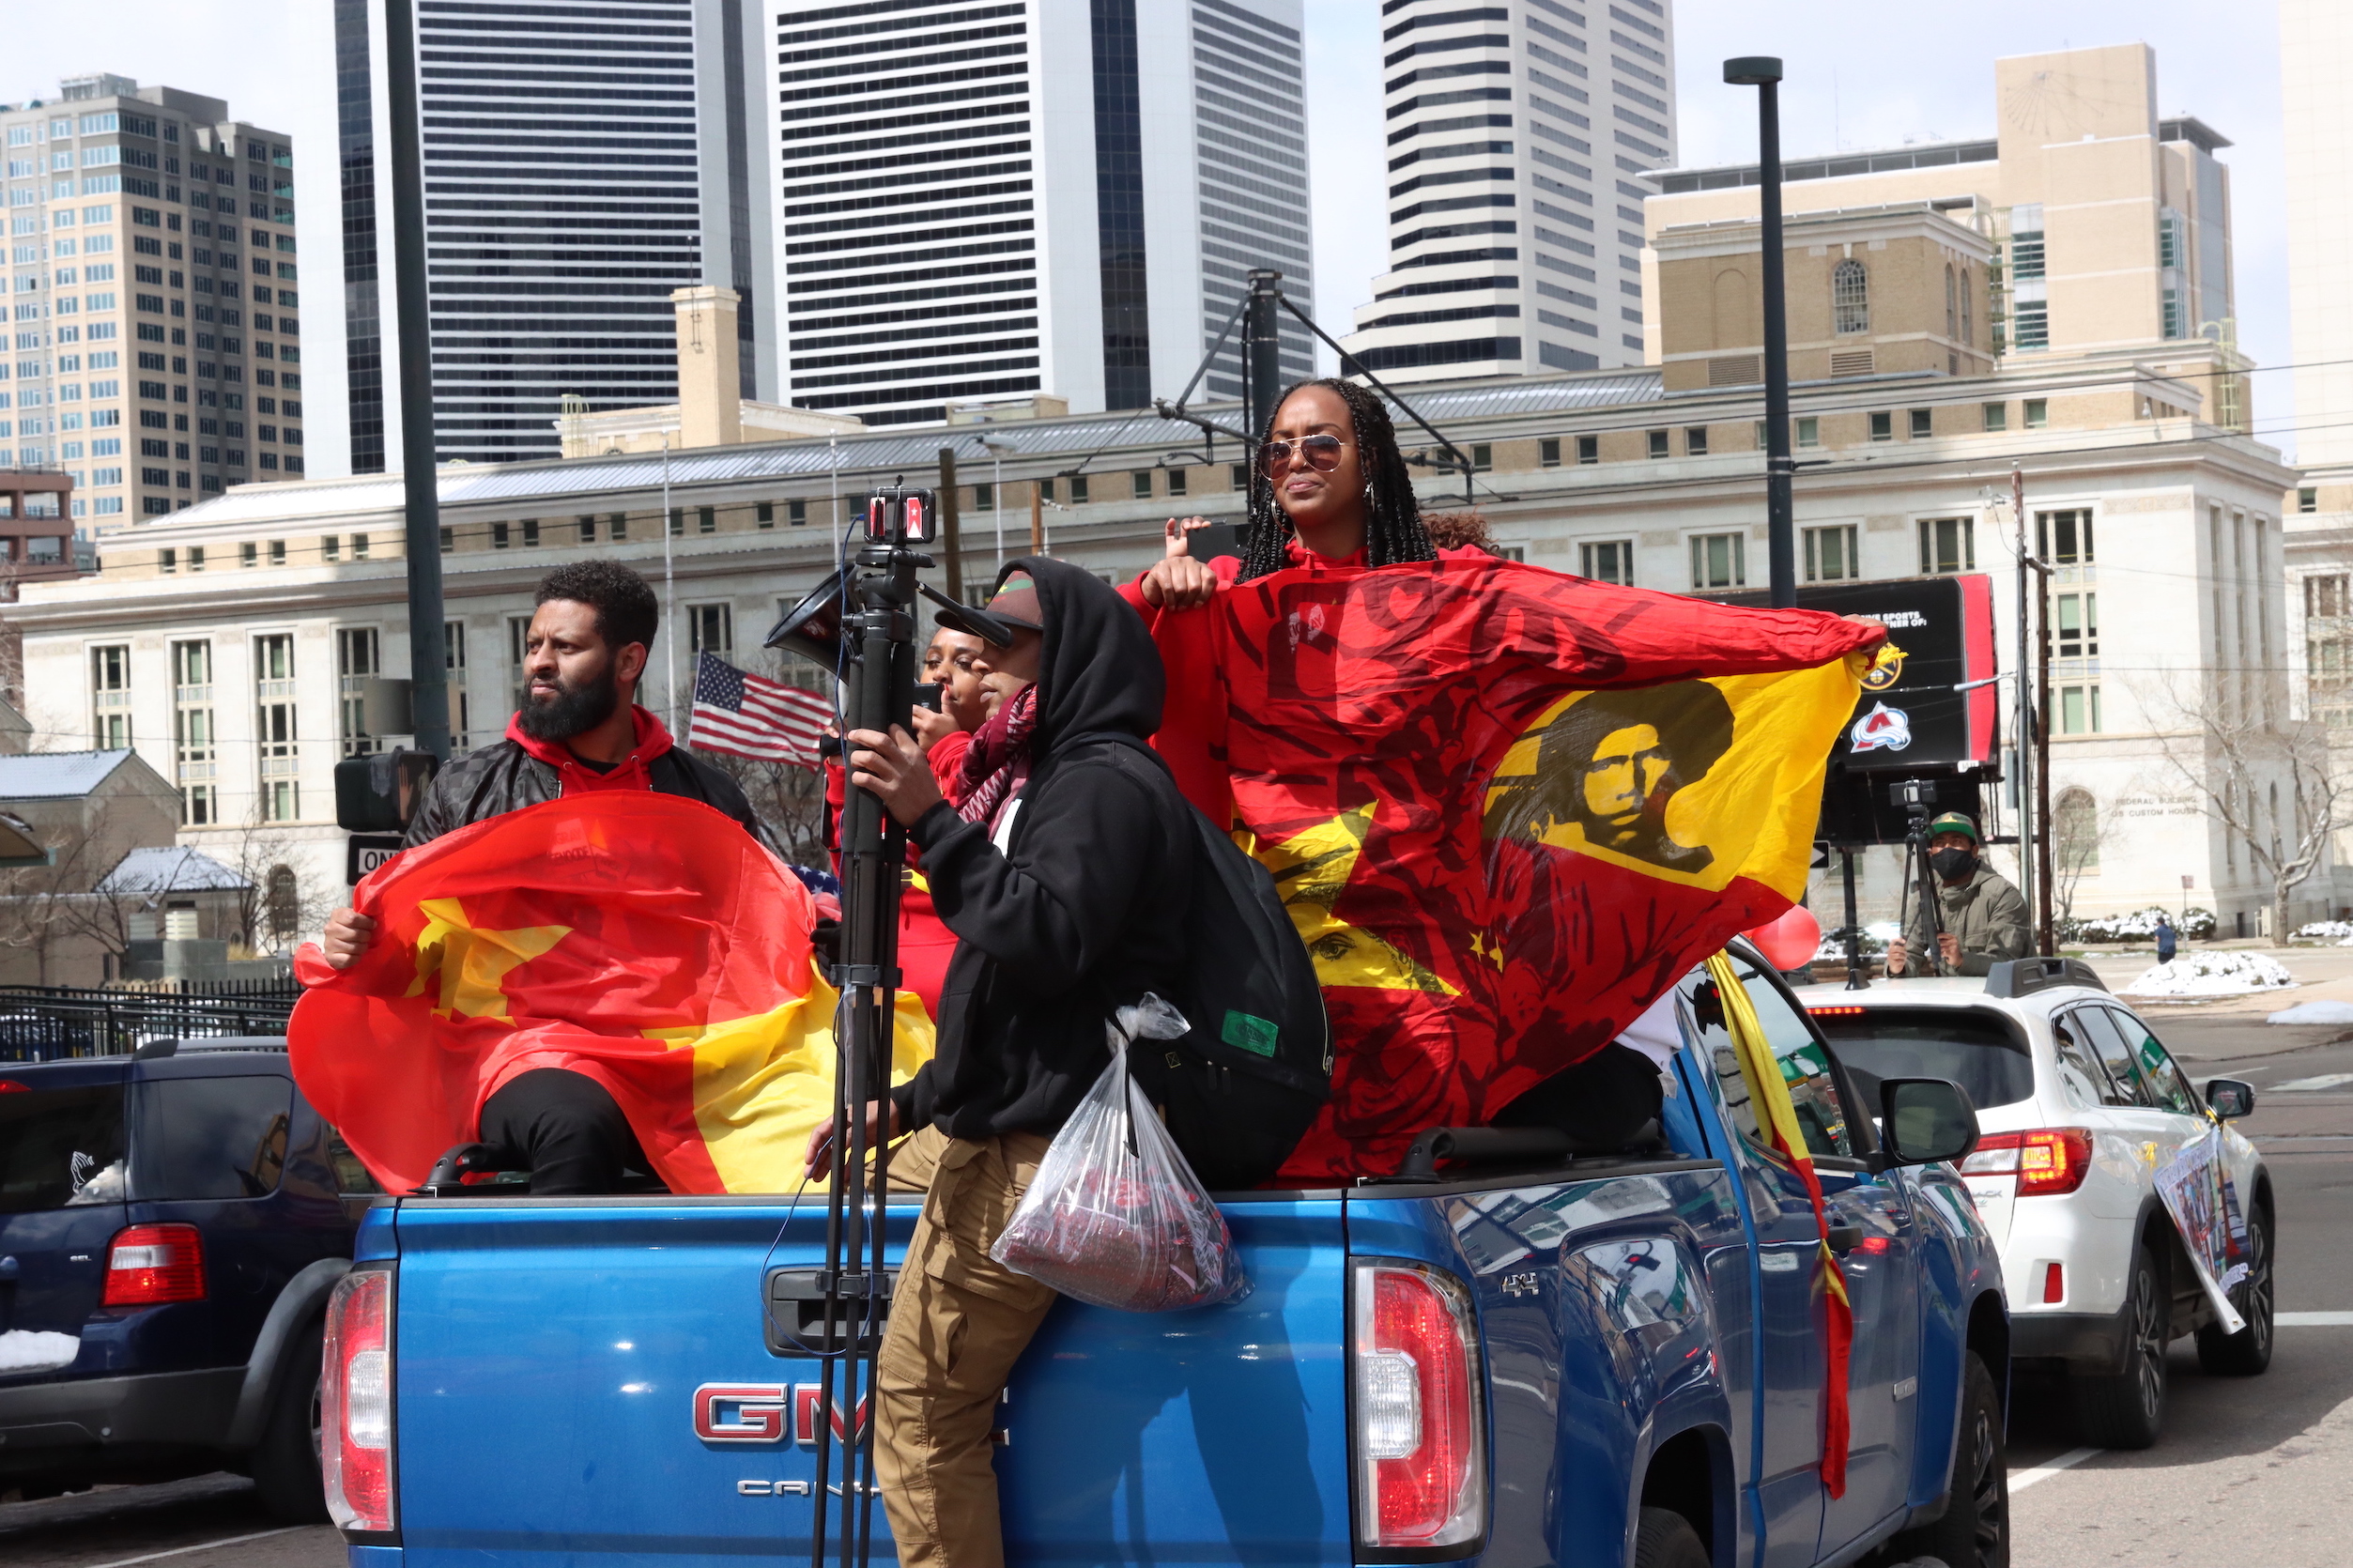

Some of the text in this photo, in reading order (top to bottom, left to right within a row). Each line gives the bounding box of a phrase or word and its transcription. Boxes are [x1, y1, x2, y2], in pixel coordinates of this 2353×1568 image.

[1883, 611, 1920, 621] SPORTS
[1911, 618, 1927, 627] OF:
[2115, 796, 2196, 806] FEDERAL BUILDING
[2129, 808, 2163, 817] CUSTOM
[364, 852, 399, 871] ON
